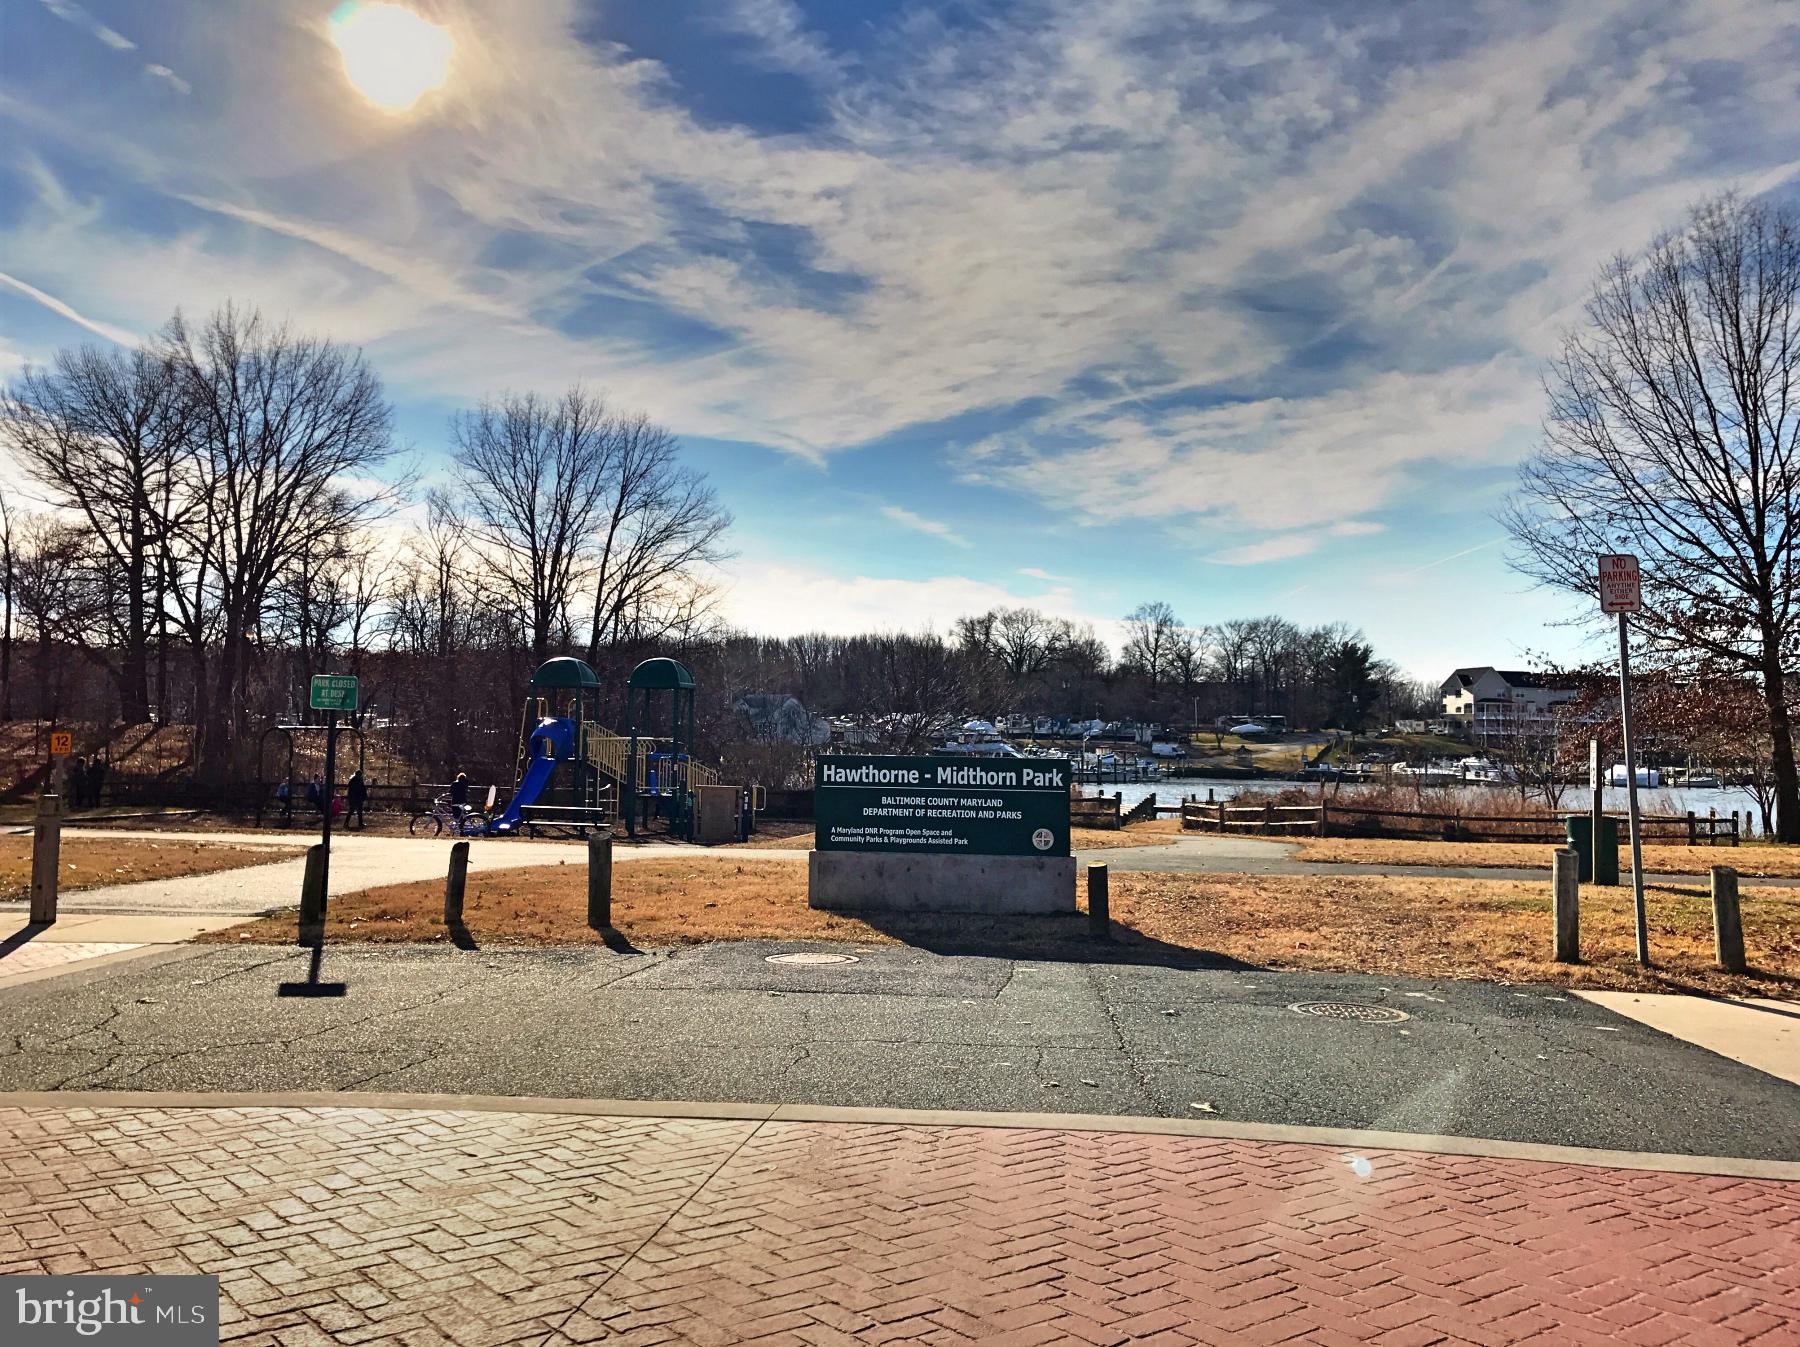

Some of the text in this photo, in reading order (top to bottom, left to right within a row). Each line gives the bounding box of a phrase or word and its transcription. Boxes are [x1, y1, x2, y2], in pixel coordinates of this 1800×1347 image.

[1612, 558, 1626, 569] NO
[1602, 570, 1637, 582] PARKING
[314, 679, 355, 688] PARK CLOSED
[56, 736, 68, 746] 12
[823, 765, 919, 784] Hawthorne
[937, 766, 1016, 786] Midthorn
[1022, 768, 1063, 786] Park
[882, 797, 925, 805] BALTIMORE
[928, 798, 958, 806] COUNTY
[863, 808, 913, 816] DEPARTMENT
[928, 809, 976, 818] RECREATION
[880, 828, 904, 836] Program
[831, 835, 864, 843] Community
[890, 836, 926, 844] Playgrounds
